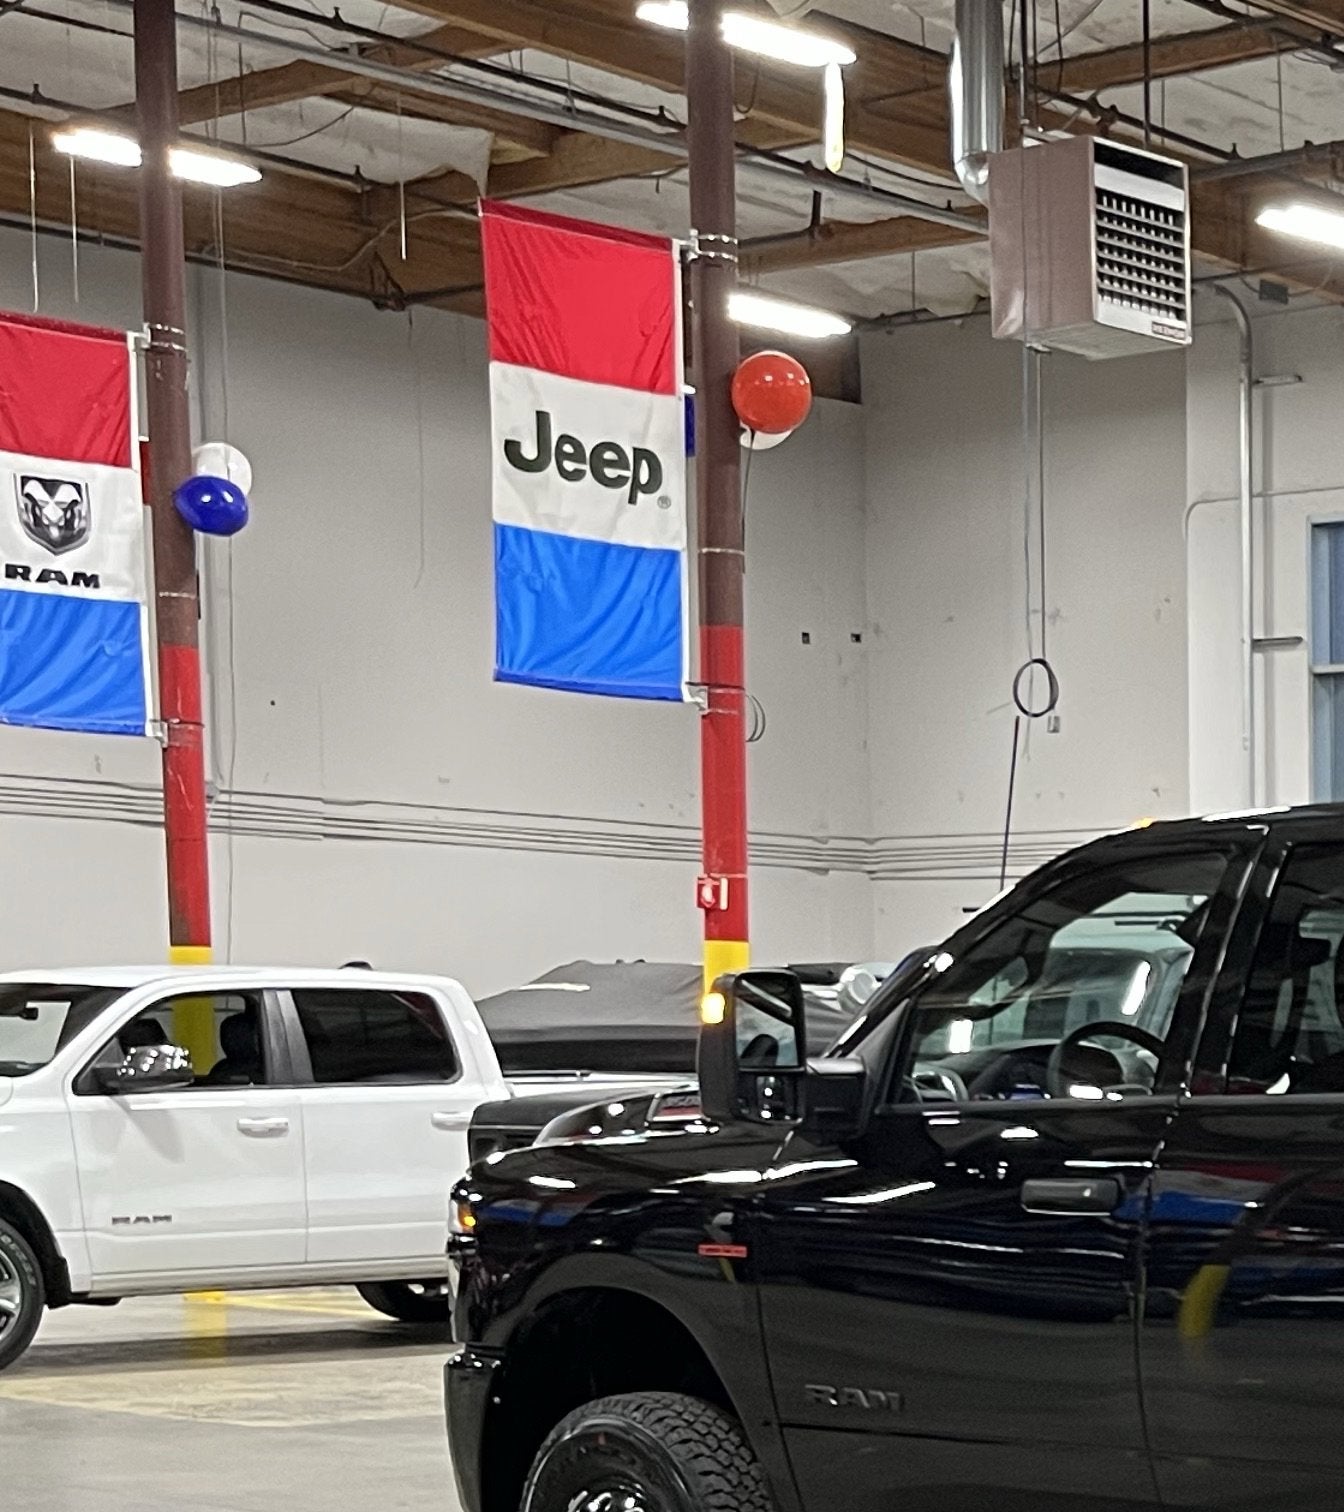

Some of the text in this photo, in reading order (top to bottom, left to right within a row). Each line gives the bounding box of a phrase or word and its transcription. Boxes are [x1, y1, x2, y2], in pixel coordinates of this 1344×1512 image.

[503, 409, 664, 506] Jeep
[4, 562, 101, 590] RAM
[111, 1214, 173, 1226] RAM
